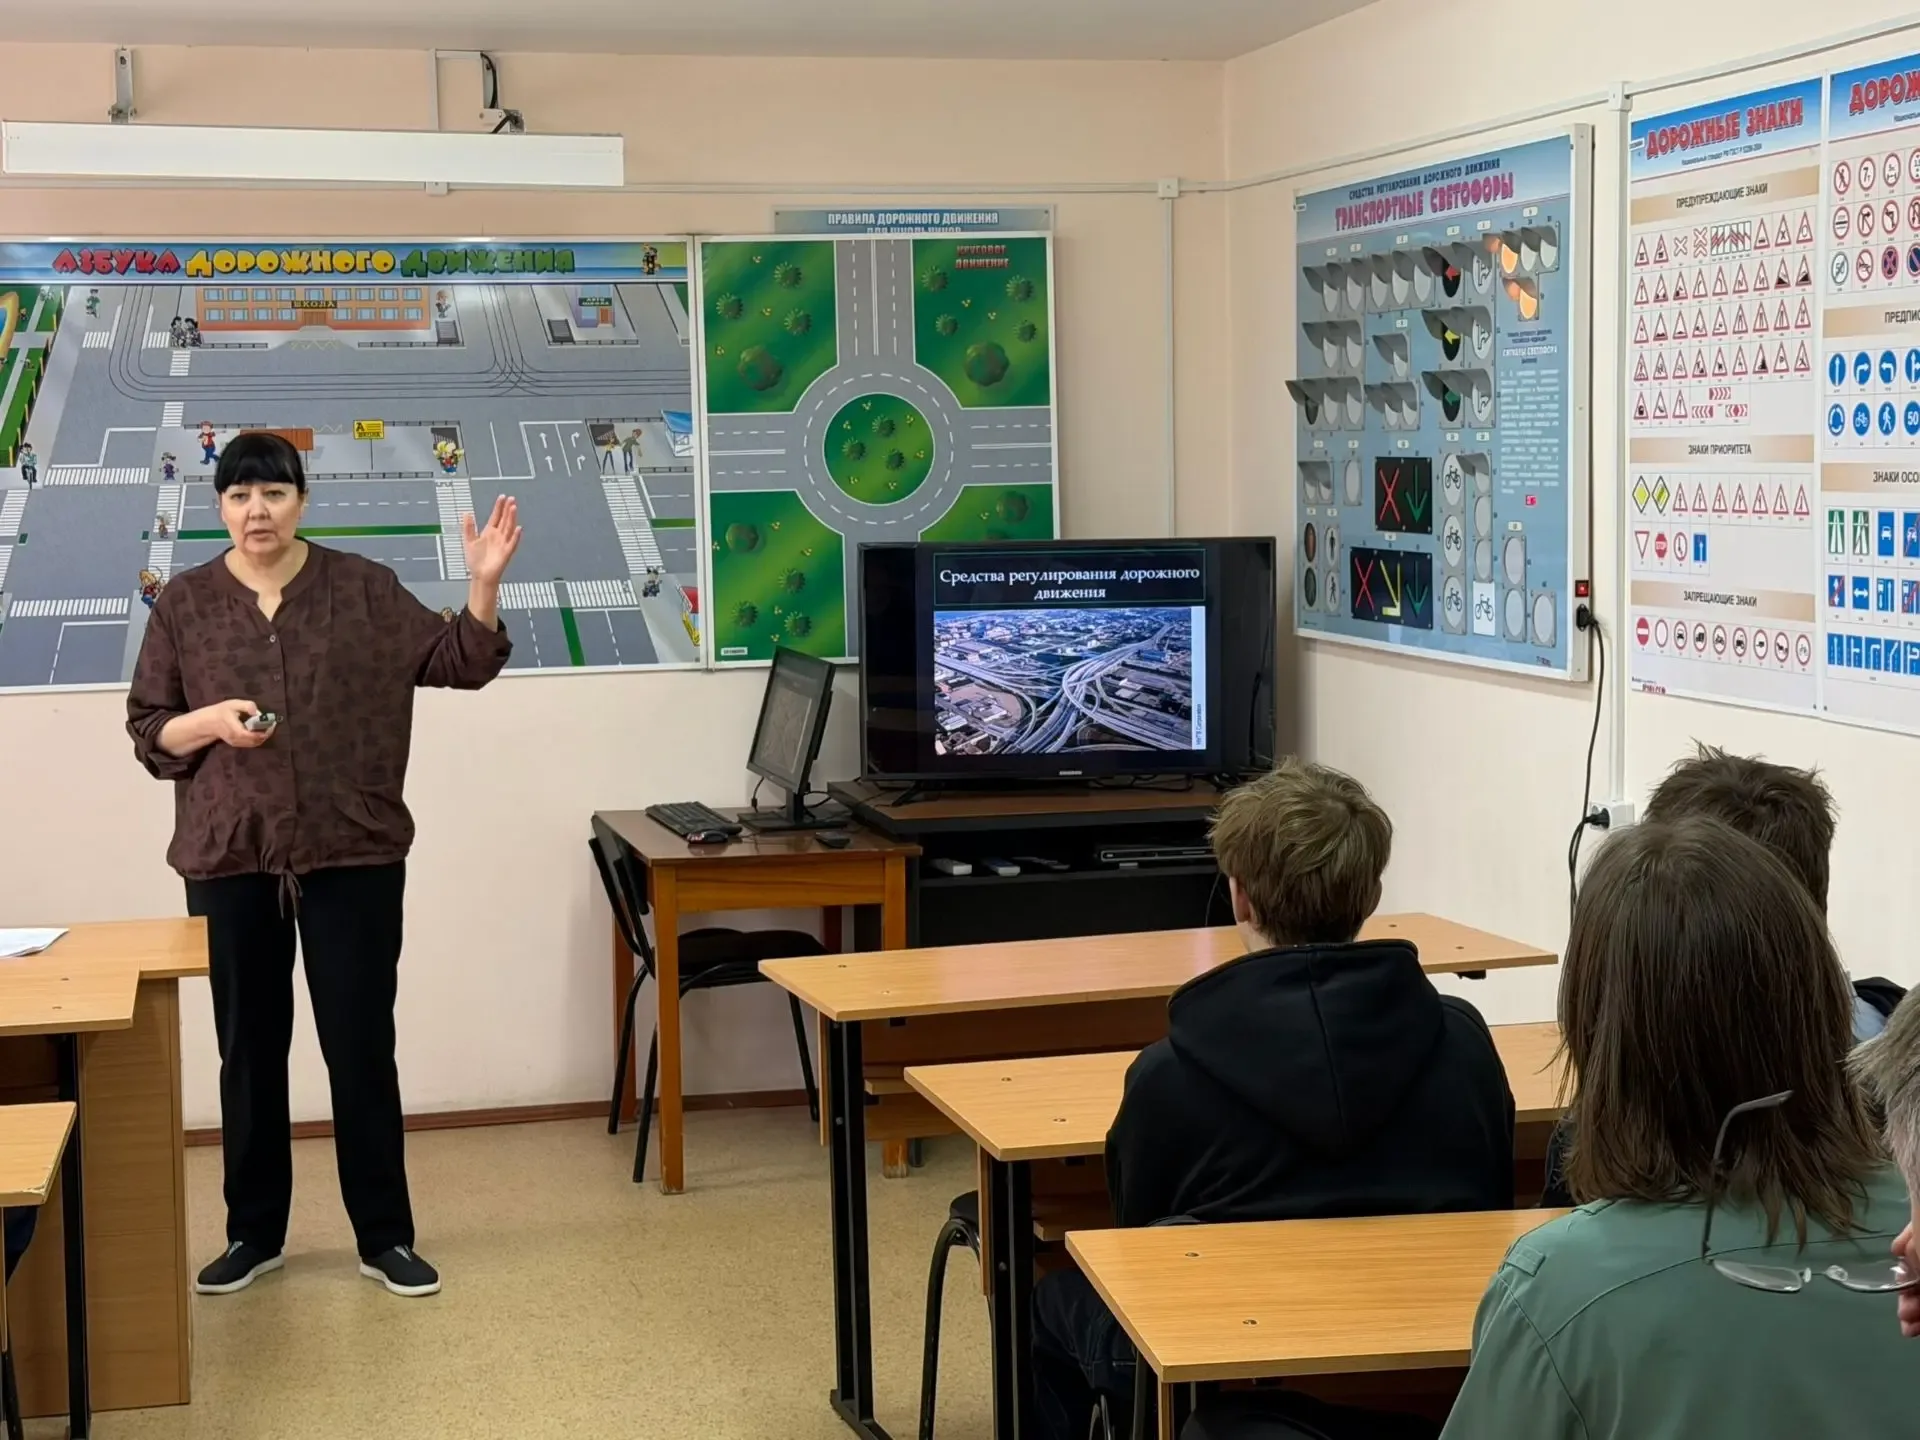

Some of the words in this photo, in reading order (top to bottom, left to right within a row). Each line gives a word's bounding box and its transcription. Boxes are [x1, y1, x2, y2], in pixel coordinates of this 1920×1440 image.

[1849, 70, 1920, 116] ДОРОЖ
[1646, 111, 1741, 160] ДОРОЖНЫЕ
[1745, 98, 1804, 137] ЗНАКИ
[1349, 187, 1375, 200] СРЕДСТВА
[1376, 176, 1421, 196] РЕГУЛИРОВАНИЯ
[1423, 168, 1463, 186] ДОРОЖНОГО
[1465, 158, 1501, 177] ДВИЖЕНИЯ
[1335, 190, 1424, 231] ТРАНСПОРТНЫЕ
[1430, 172, 1514, 213] СВЕТОФОРЫ
[1676, 186, 1744, 208] ПРЕДУПРЕЖДАЮЩИЕ
[1745, 183, 1768, 197] ЗНАКИ
[828, 213, 875, 225] ПРАВИЛА
[877, 213, 940, 226] ДОРОЖНОГО
[942, 212, 998, 225] ДВИЖЕНИЯ
[52, 248, 181, 275] АЗБУКА
[186, 248, 395, 276] ДОРОЖНОГО
[400, 248, 576, 276] ДВИЖЕНИЯ
[955, 258, 1009, 269] ДВИЖЕНИЕ
[294, 300, 335, 308] ШКОЛА
[1907, 411, 1919, 426] 50
[1688, 444, 1709, 455] ЗНАКИ
[1710, 443, 1752, 455] ПРИОРИТЕТА
[1873, 471, 1900, 483] ЗНАКИ
[939, 569, 1005, 584] Средства
[1009, 570, 1117, 586] регулирования
[1120, 568, 1200, 584] дорожного
[1034, 586, 1106, 600] движения
[1684, 590, 1735, 606] ЗАПРЕЩАЮЩИЕ
[1736, 595, 1757, 607] ЗНАКИ
